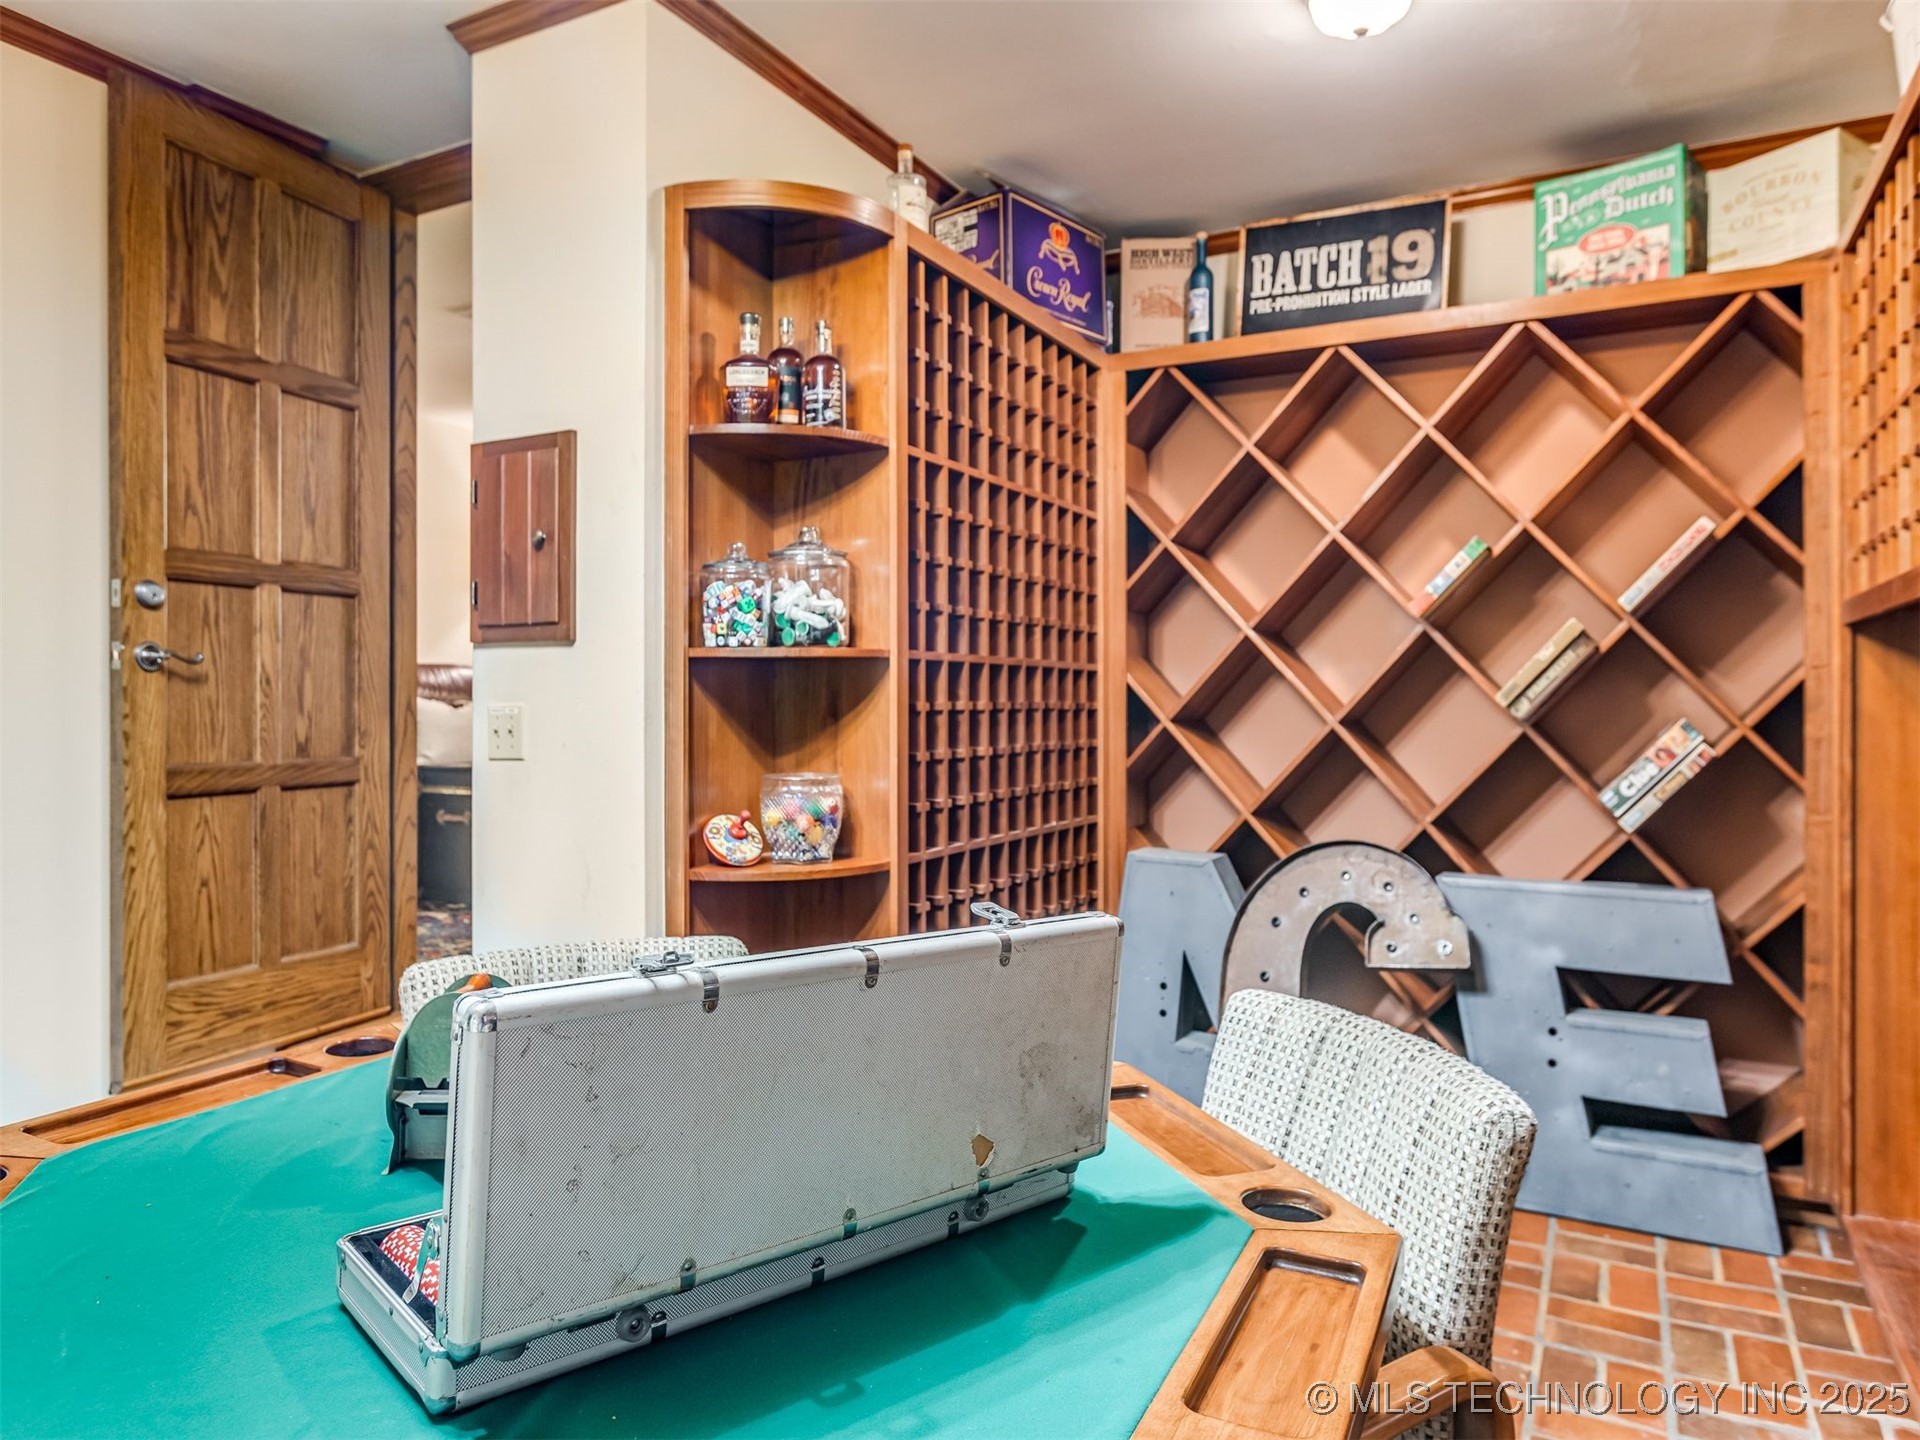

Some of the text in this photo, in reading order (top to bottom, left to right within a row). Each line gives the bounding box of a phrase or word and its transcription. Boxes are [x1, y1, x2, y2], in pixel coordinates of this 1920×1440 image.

[1538, 164, 1677, 251] Pennsylvania
[1604, 184, 1675, 220] Dutch
[1719, 171, 1822, 215] BOURBON
[1728, 194, 1814, 234] COUNTY
[1130, 247, 1194, 258] HIGH WEST
[1250, 228, 1436, 298] BATCH 19
[1026, 265, 1093, 313] Crown Royal
[1250, 278, 1433, 316] PRE-PROHIBITION STYLE LAGER
